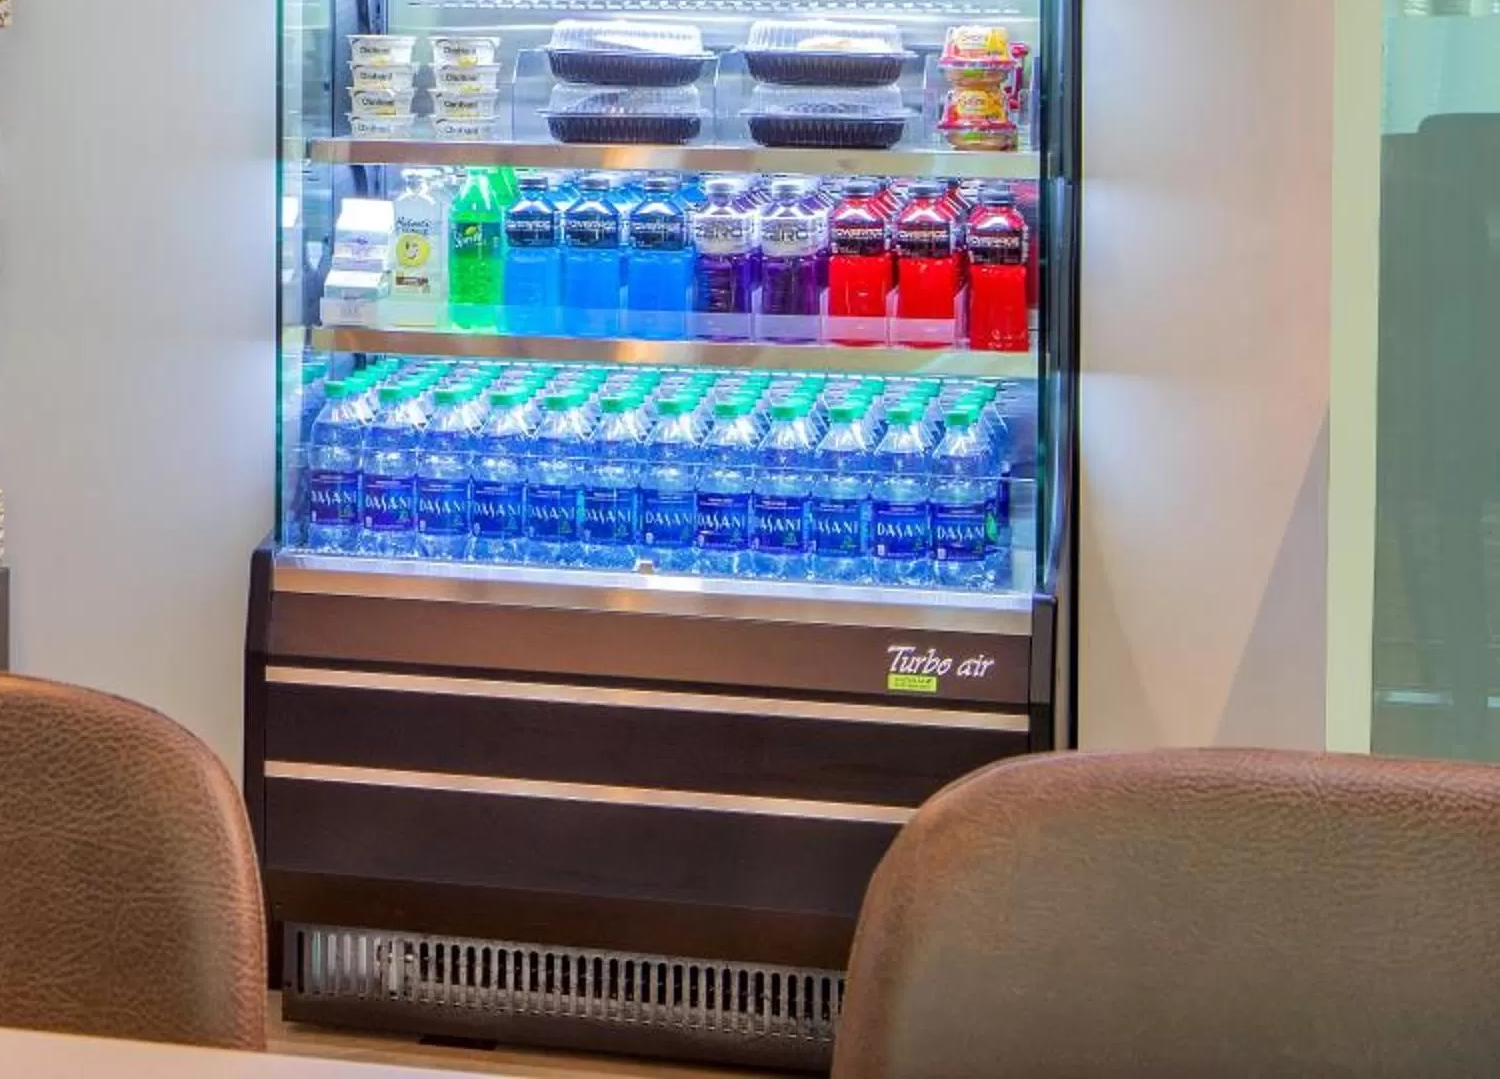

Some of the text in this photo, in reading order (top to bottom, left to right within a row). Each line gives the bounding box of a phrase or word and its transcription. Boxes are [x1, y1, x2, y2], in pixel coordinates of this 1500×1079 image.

[365, 494, 412, 512] DASANI
[759, 515, 801, 533] ASANI
[815, 517, 859, 536] ASANI
[887, 645, 995, 678] Turbo air
